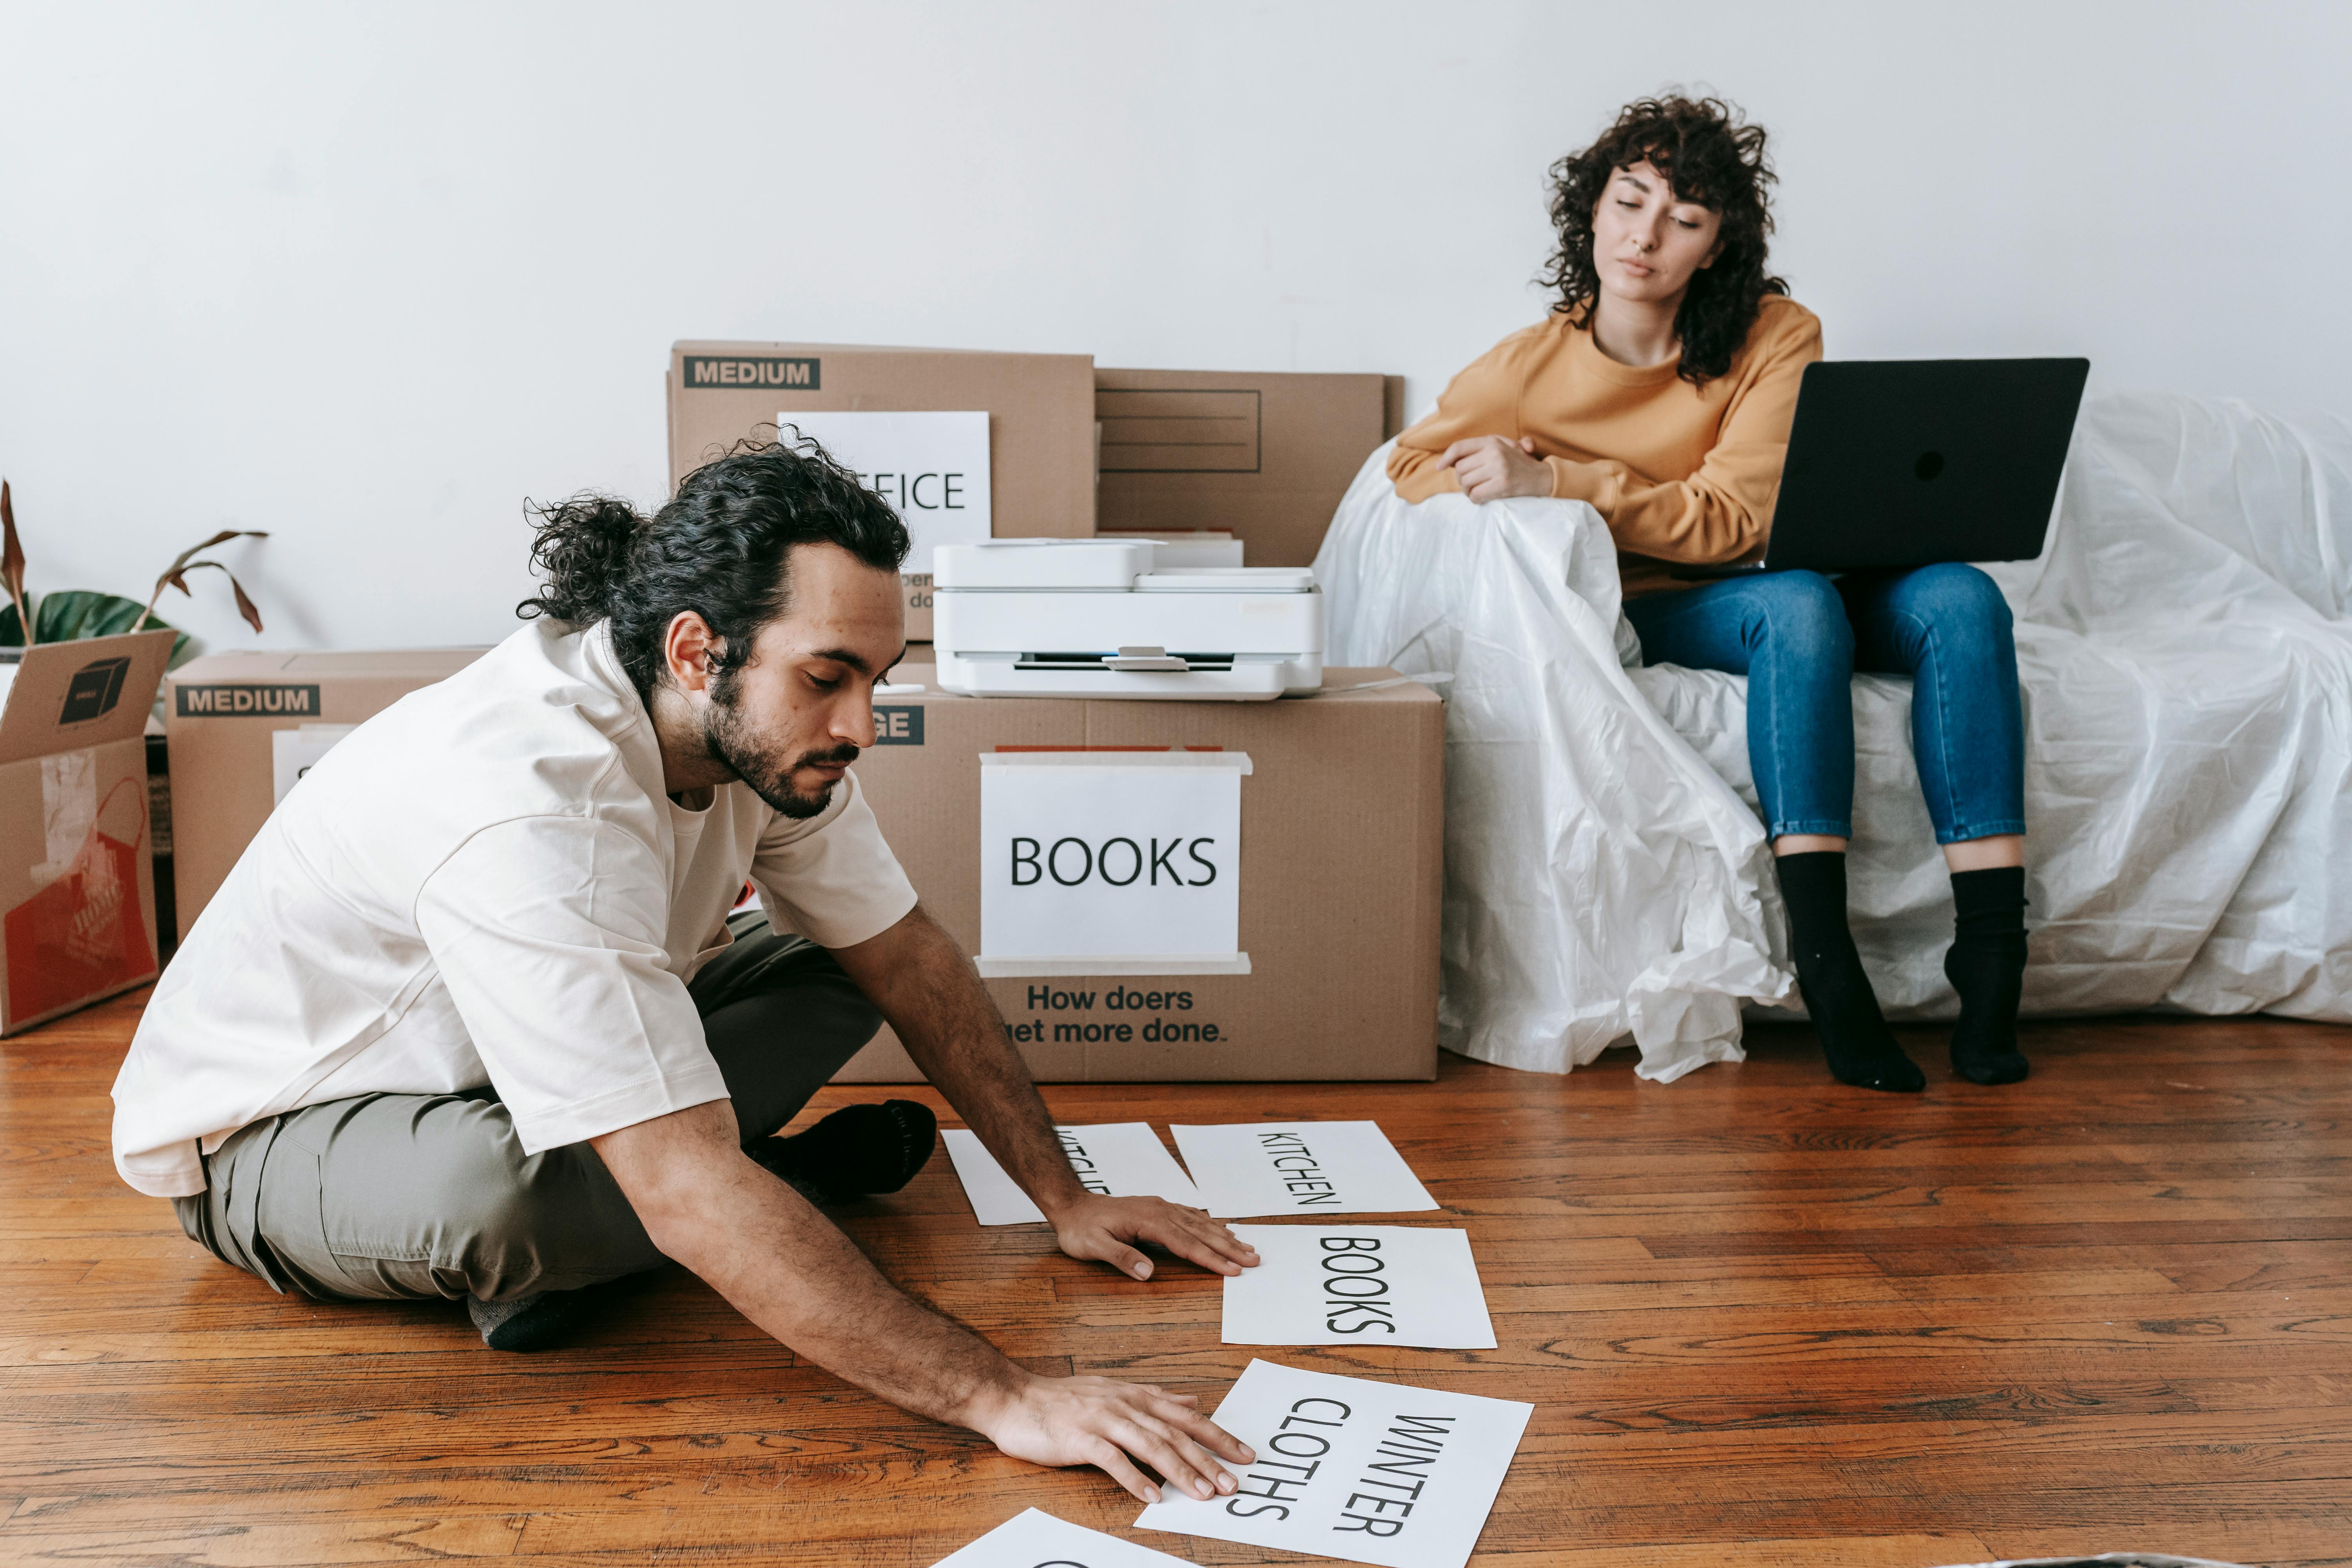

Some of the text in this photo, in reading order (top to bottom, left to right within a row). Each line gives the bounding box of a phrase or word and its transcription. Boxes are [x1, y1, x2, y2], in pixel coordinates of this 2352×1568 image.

[694, 361, 810, 384] MEDIUM
[858, 474, 965, 509] FICE
[187, 688, 309, 711] MEDIUM
[1012, 837, 1216, 886] BOOKS
[1028, 985, 1193, 1011] How doers
[1054, 1024, 1133, 1043] more
[1258, 1133, 1341, 1205] KITCHEN
[1320, 1237, 1396, 1334] BOOKS
[1226, 1398, 1351, 1521] CLOTHS
[1332, 1415, 1456, 1537] WINTER
